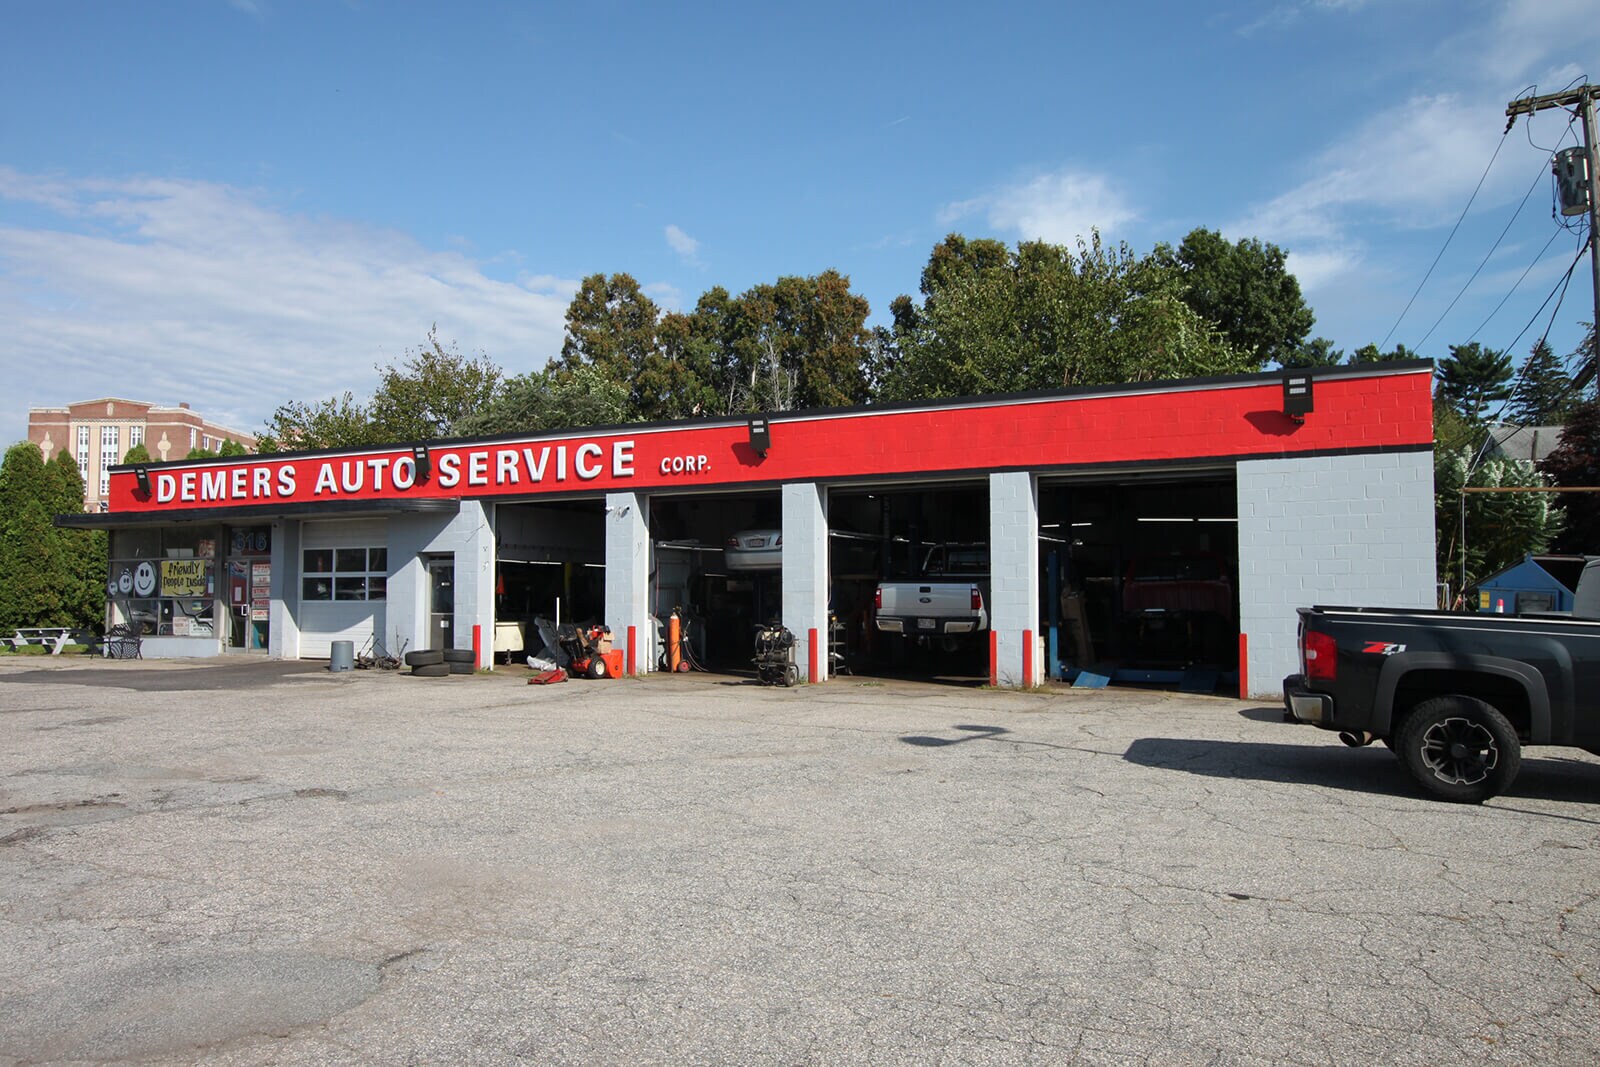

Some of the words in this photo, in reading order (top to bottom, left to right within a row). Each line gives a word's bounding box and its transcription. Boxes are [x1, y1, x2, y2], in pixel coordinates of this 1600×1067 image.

[157, 465, 296, 503] DEMERS
[314, 456, 416, 494] AUTO
[438, 440, 635, 487] SERVICE
[660, 455, 712, 473] CORP.
